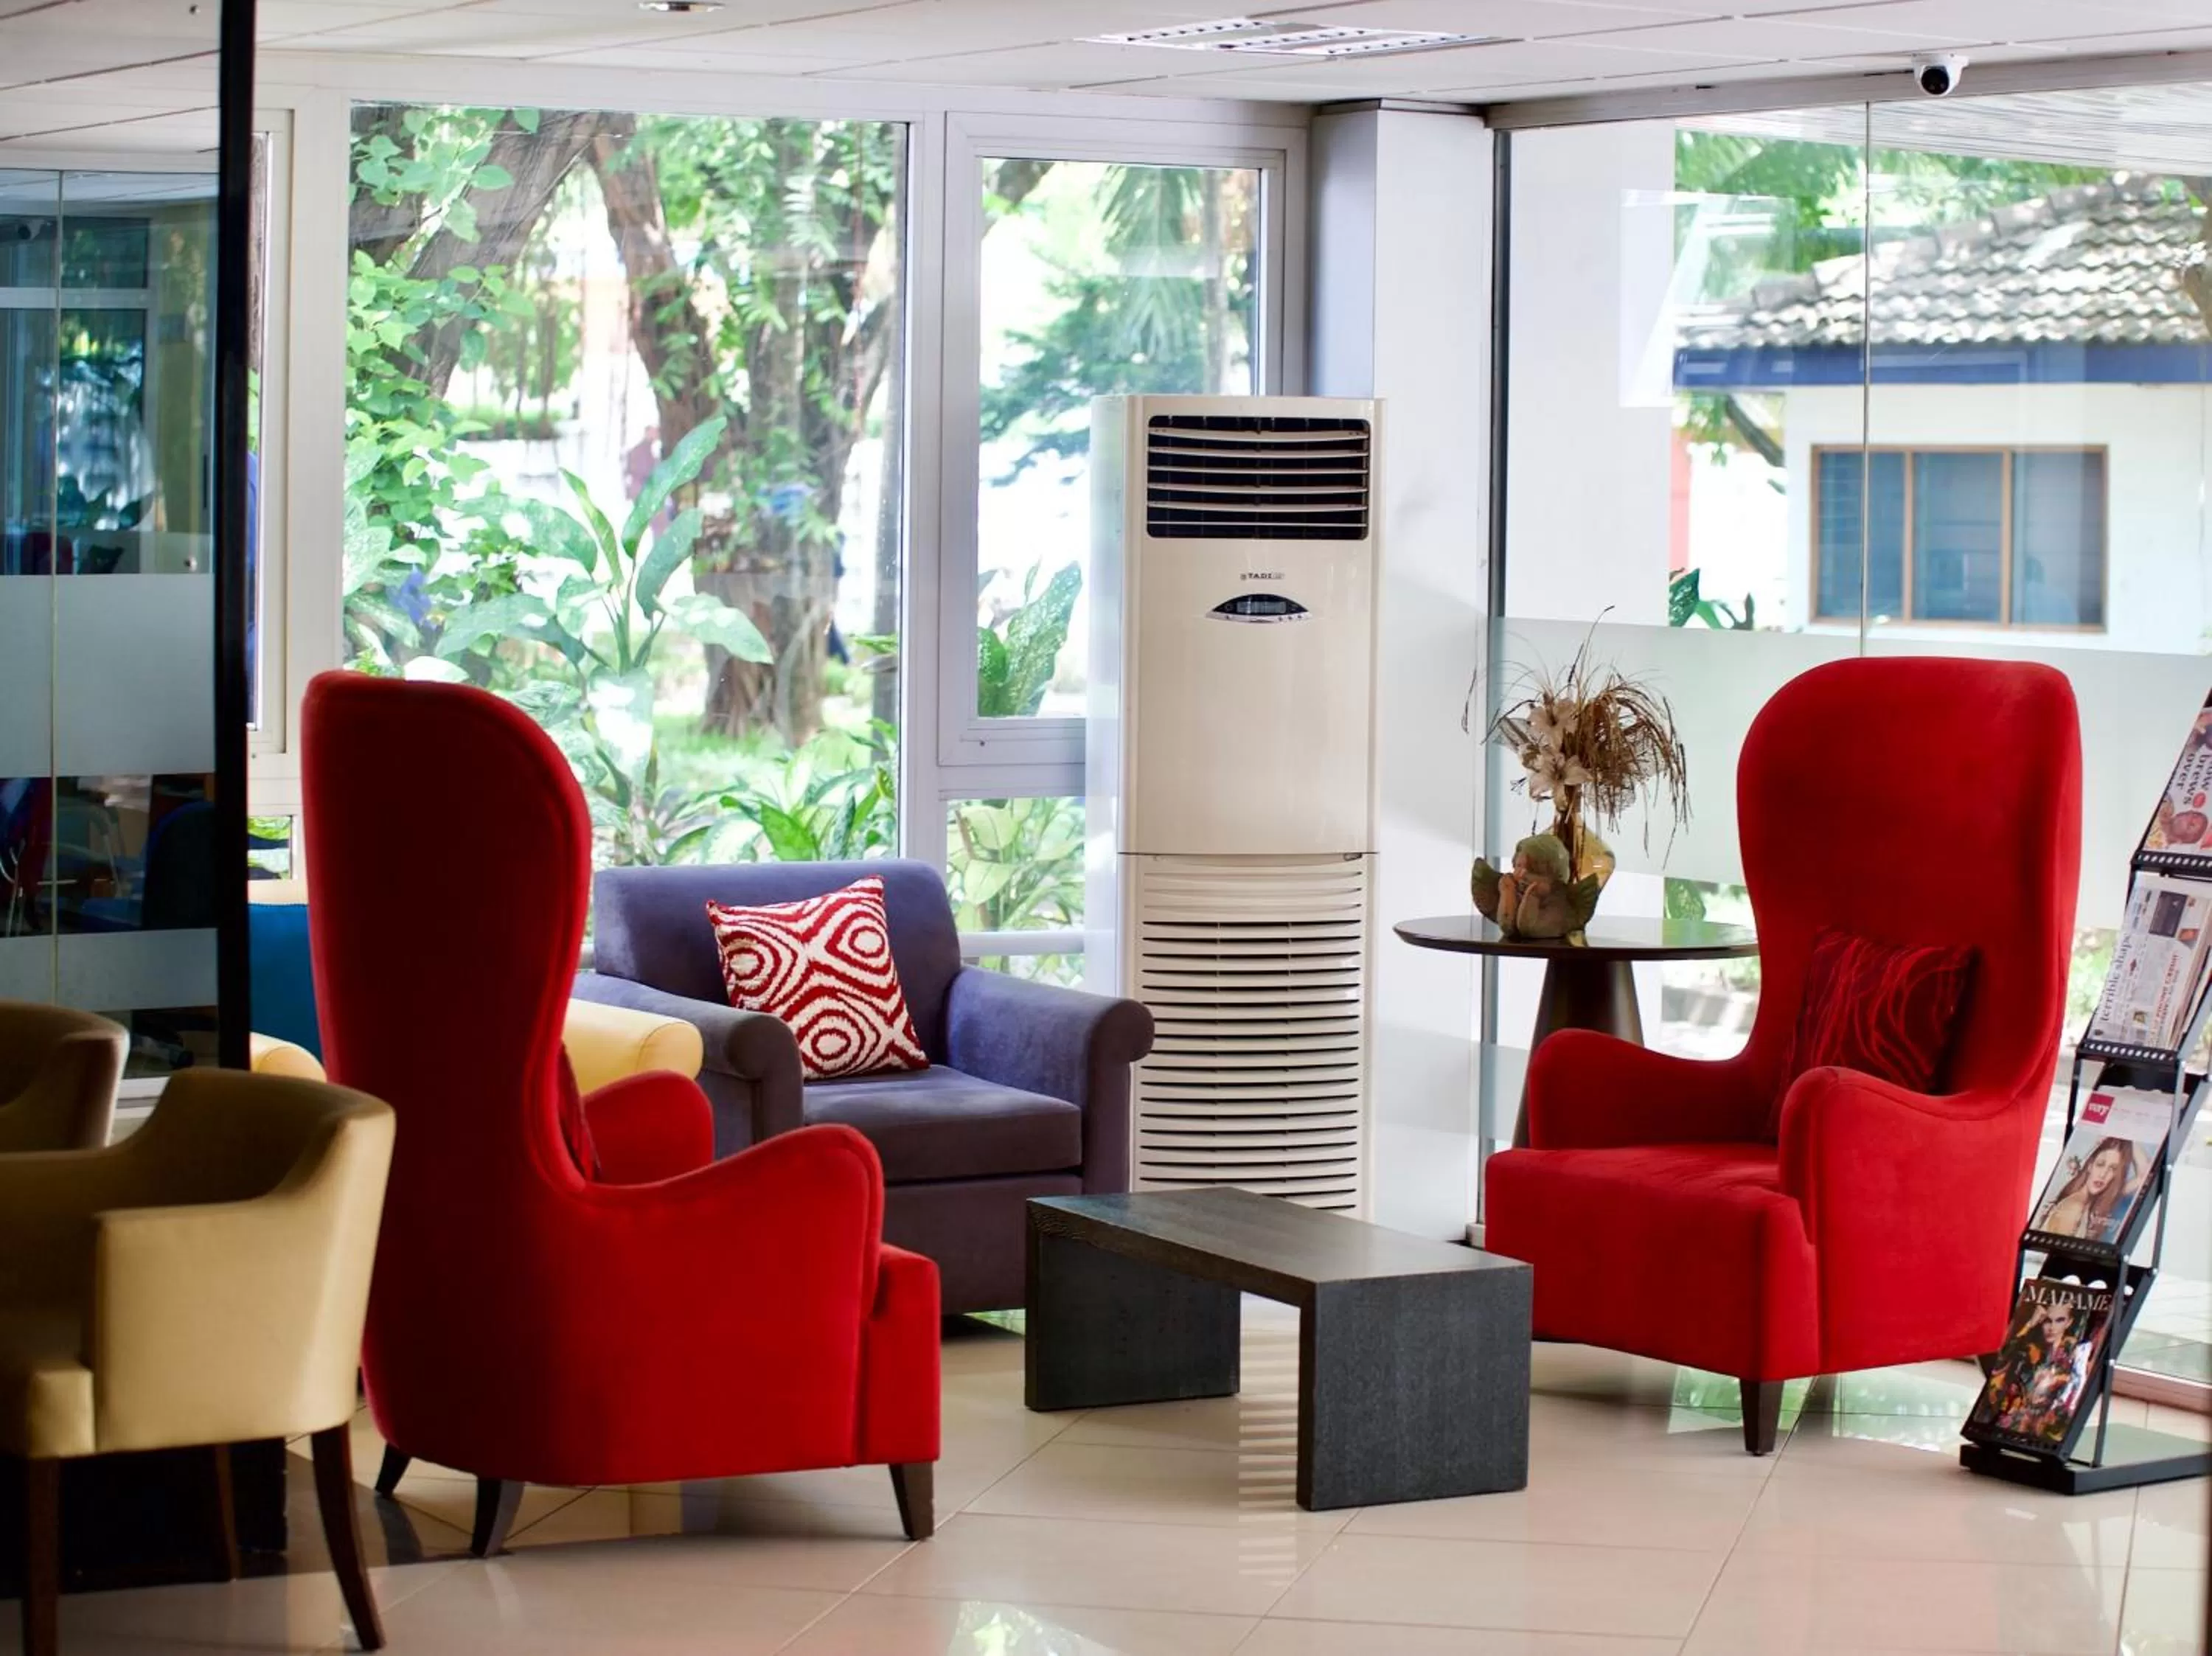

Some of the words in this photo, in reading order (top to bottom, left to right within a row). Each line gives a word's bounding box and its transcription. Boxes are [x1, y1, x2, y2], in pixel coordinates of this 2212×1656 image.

[2177, 753, 2196, 790] over
[2183, 754, 2211, 804] brews
[2101, 971, 2120, 1021] terrible
[2025, 1285, 2112, 1310] MADAME
